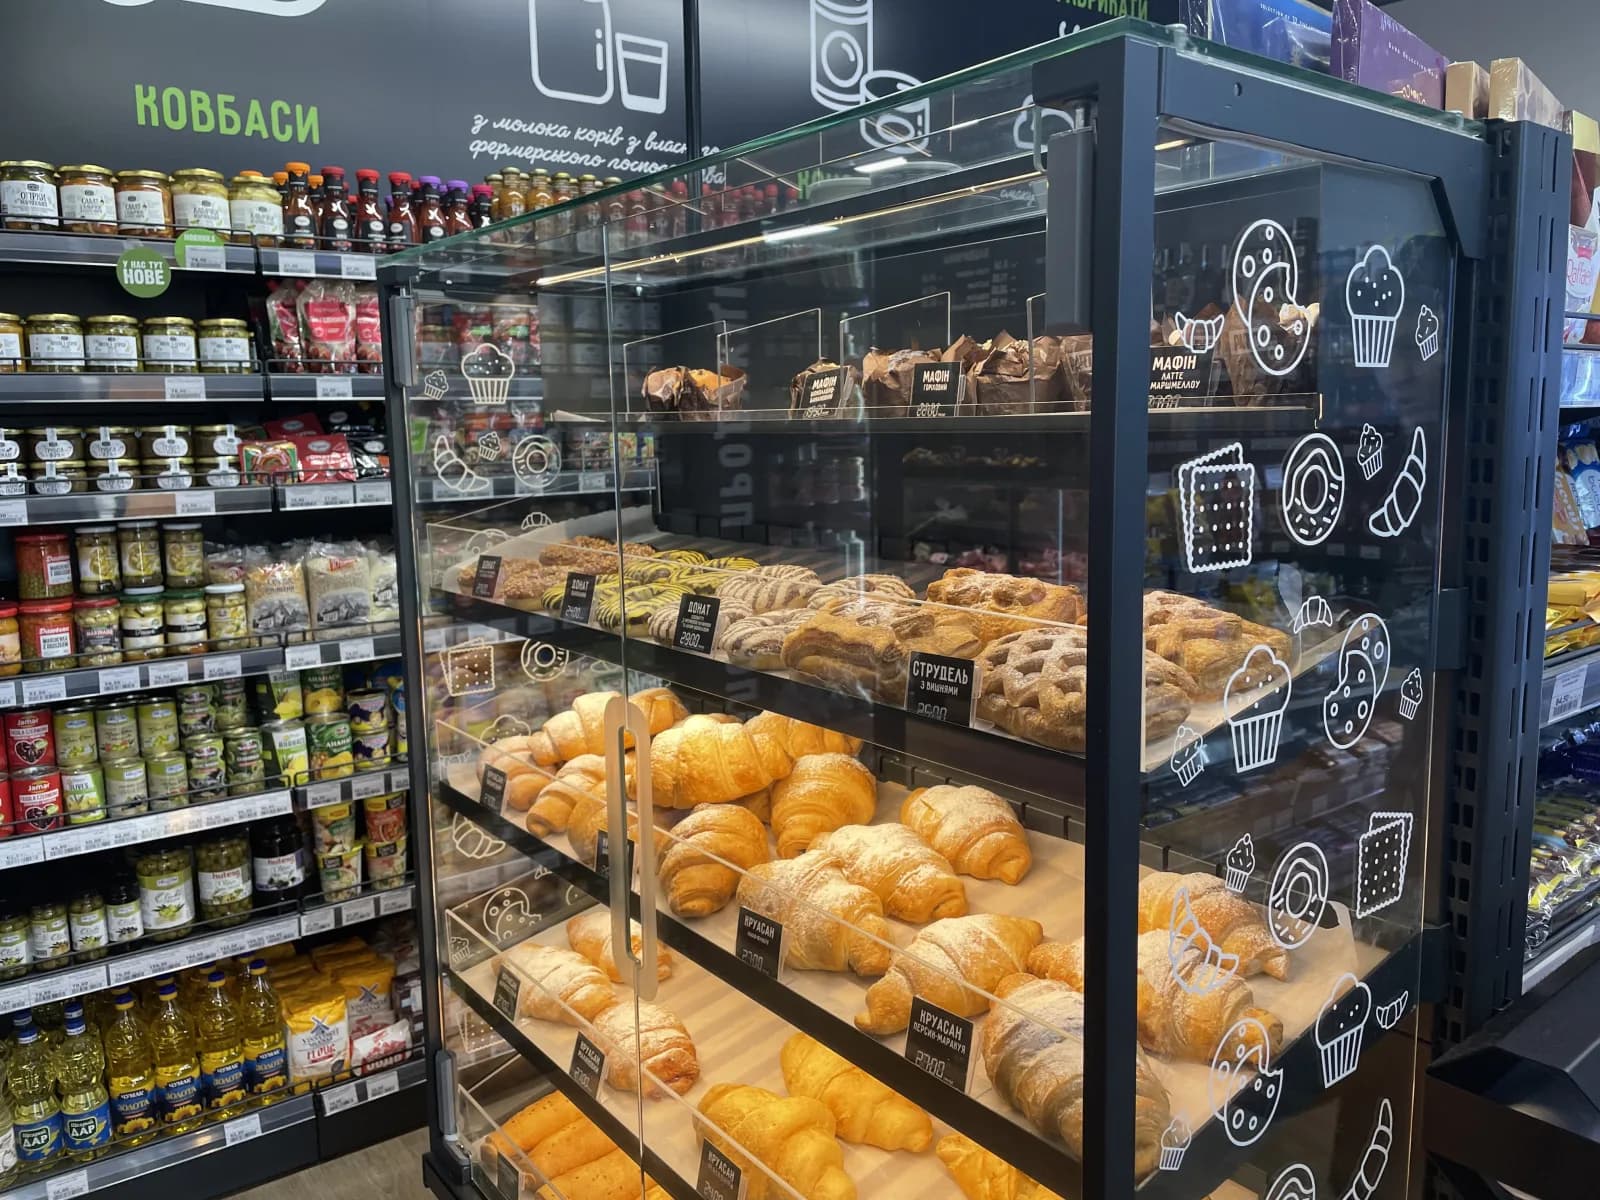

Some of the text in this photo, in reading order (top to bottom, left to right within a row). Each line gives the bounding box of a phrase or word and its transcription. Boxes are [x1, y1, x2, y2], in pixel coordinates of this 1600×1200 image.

[134, 84, 320, 145] КОВБАСИ
[471, 114, 488, 134] з
[493, 118, 572, 139] молока
[574, 126, 624, 148] корів
[626, 135, 640, 154] з
[469, 138, 606, 168] фермерського
[122, 260, 163, 269] У НАС ТУТ
[122, 269, 165, 285] НОВЕ
[1152, 355, 1197, 371] МАФІН
[811, 375, 838, 390] МАФІН
[922, 369, 950, 383] МАФІН
[1161, 371, 1184, 380] ЛАТТЕ
[1149, 380, 1201, 390] МАРШМЕЛЛОУ
[571, 578, 589, 590] ДОНАТ
[687, 601, 711, 616] ДОНАТ
[912, 660, 969, 685] СТРУДЕЛЬ
[919, 680, 959, 696] З ВИШНЯМИ
[17, 718, 39, 726] Jamar
[28, 783, 50, 792] Jamar
[744, 914, 775, 940] КРУАСАН
[919, 1008, 962, 1041] КРУАСАН
[71, 1124, 96, 1137] ДАР
[23, 1134, 49, 1147] ДАР
[708, 1149, 735, 1181] КРУАСАН
